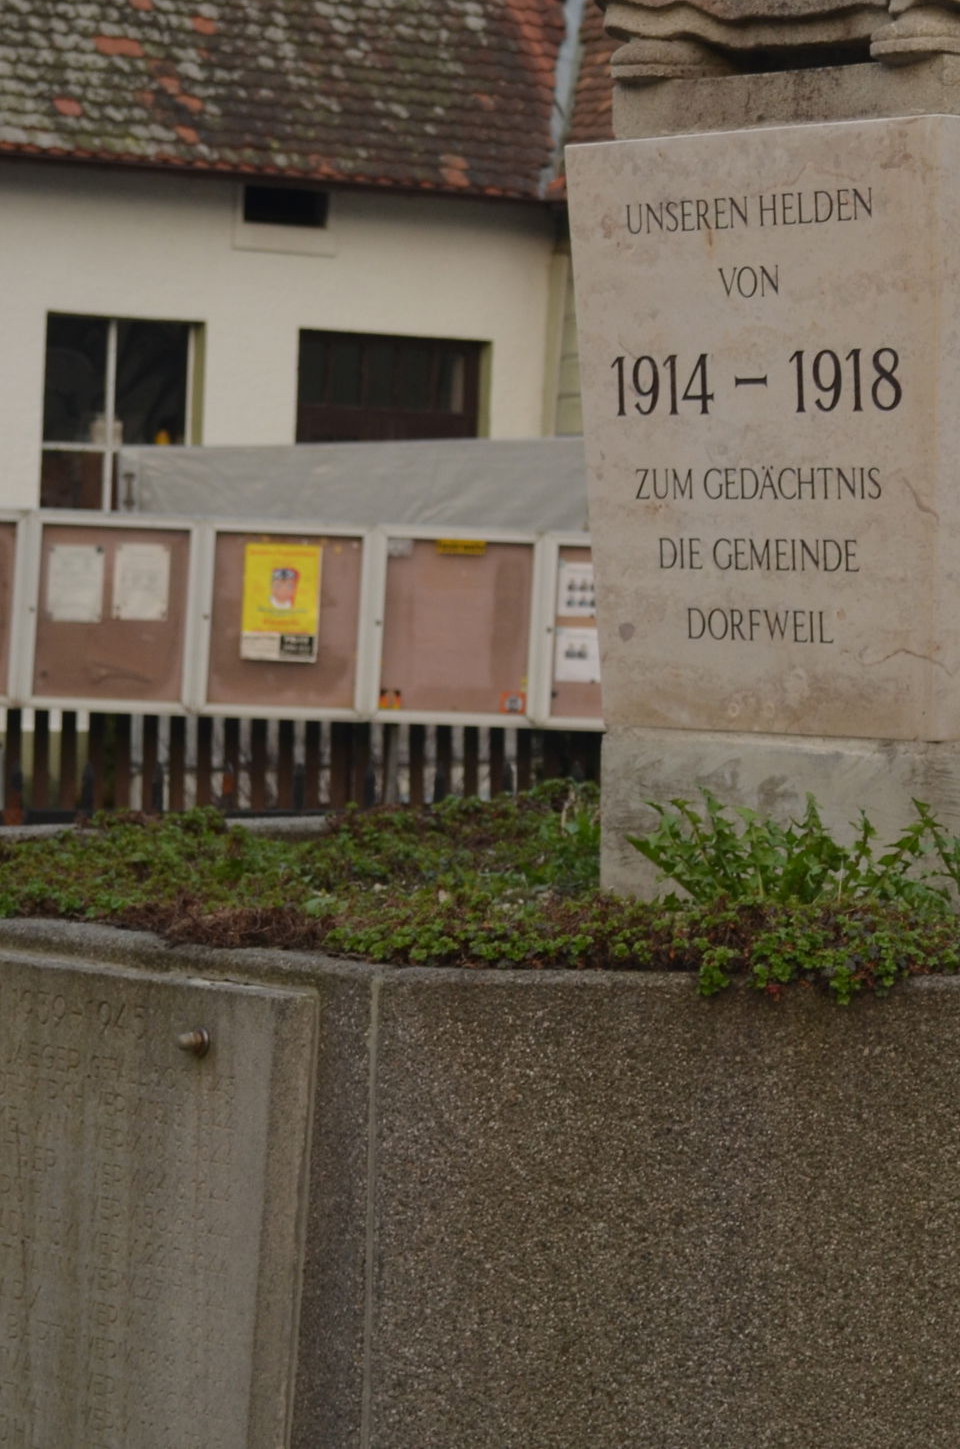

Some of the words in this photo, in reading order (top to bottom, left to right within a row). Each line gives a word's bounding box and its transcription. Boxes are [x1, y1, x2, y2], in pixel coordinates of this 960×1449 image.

[626, 196, 748, 235] UNSEREN
[758, 188, 873, 227] HELDEN
[717, 265, 779, 299] VON
[610, 352, 715, 417] 1914
[788, 347, 903, 414] 1918
[635, 468, 694, 500] ZUM
[703, 465, 882, 501] GEDÄCHTNIS
[658, 537, 704, 570] DIE
[712, 537, 860, 573] GEMEINDE
[687, 607, 834, 644] DORFWEIL
